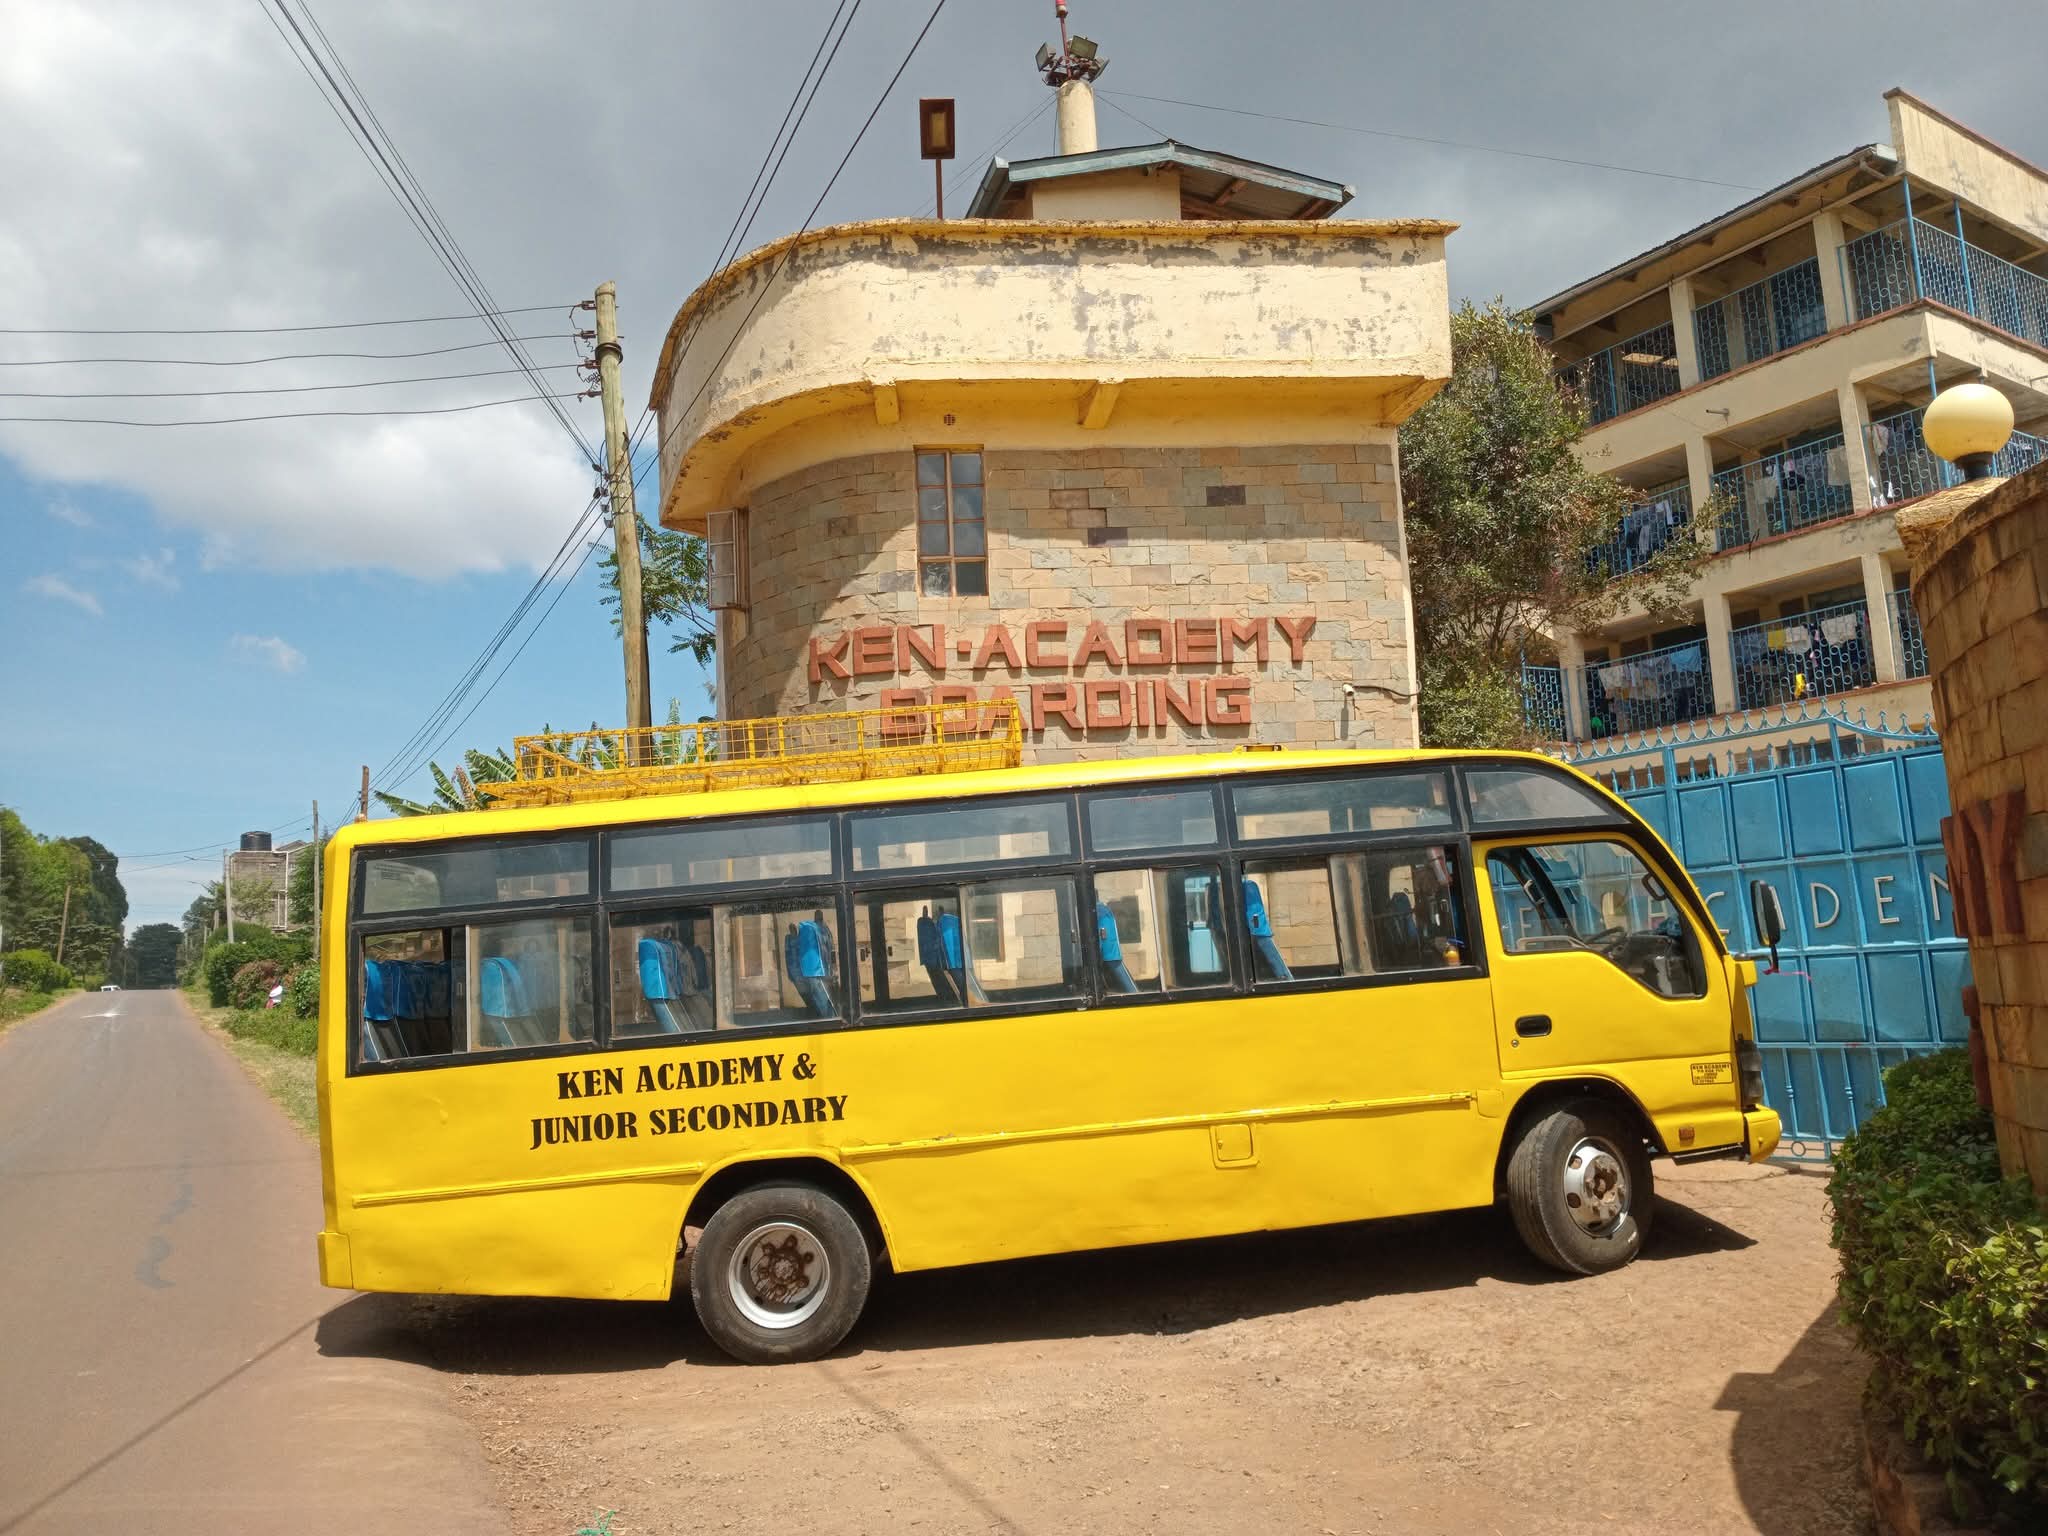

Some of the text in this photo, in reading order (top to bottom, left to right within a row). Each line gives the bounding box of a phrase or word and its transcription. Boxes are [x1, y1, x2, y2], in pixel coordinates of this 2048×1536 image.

[880, 678, 1251, 736] BOARDING
[557, 1053, 817, 1100] KEN ACADEMY &
[530, 1095, 848, 1150] JUNIOR SECONDARY
